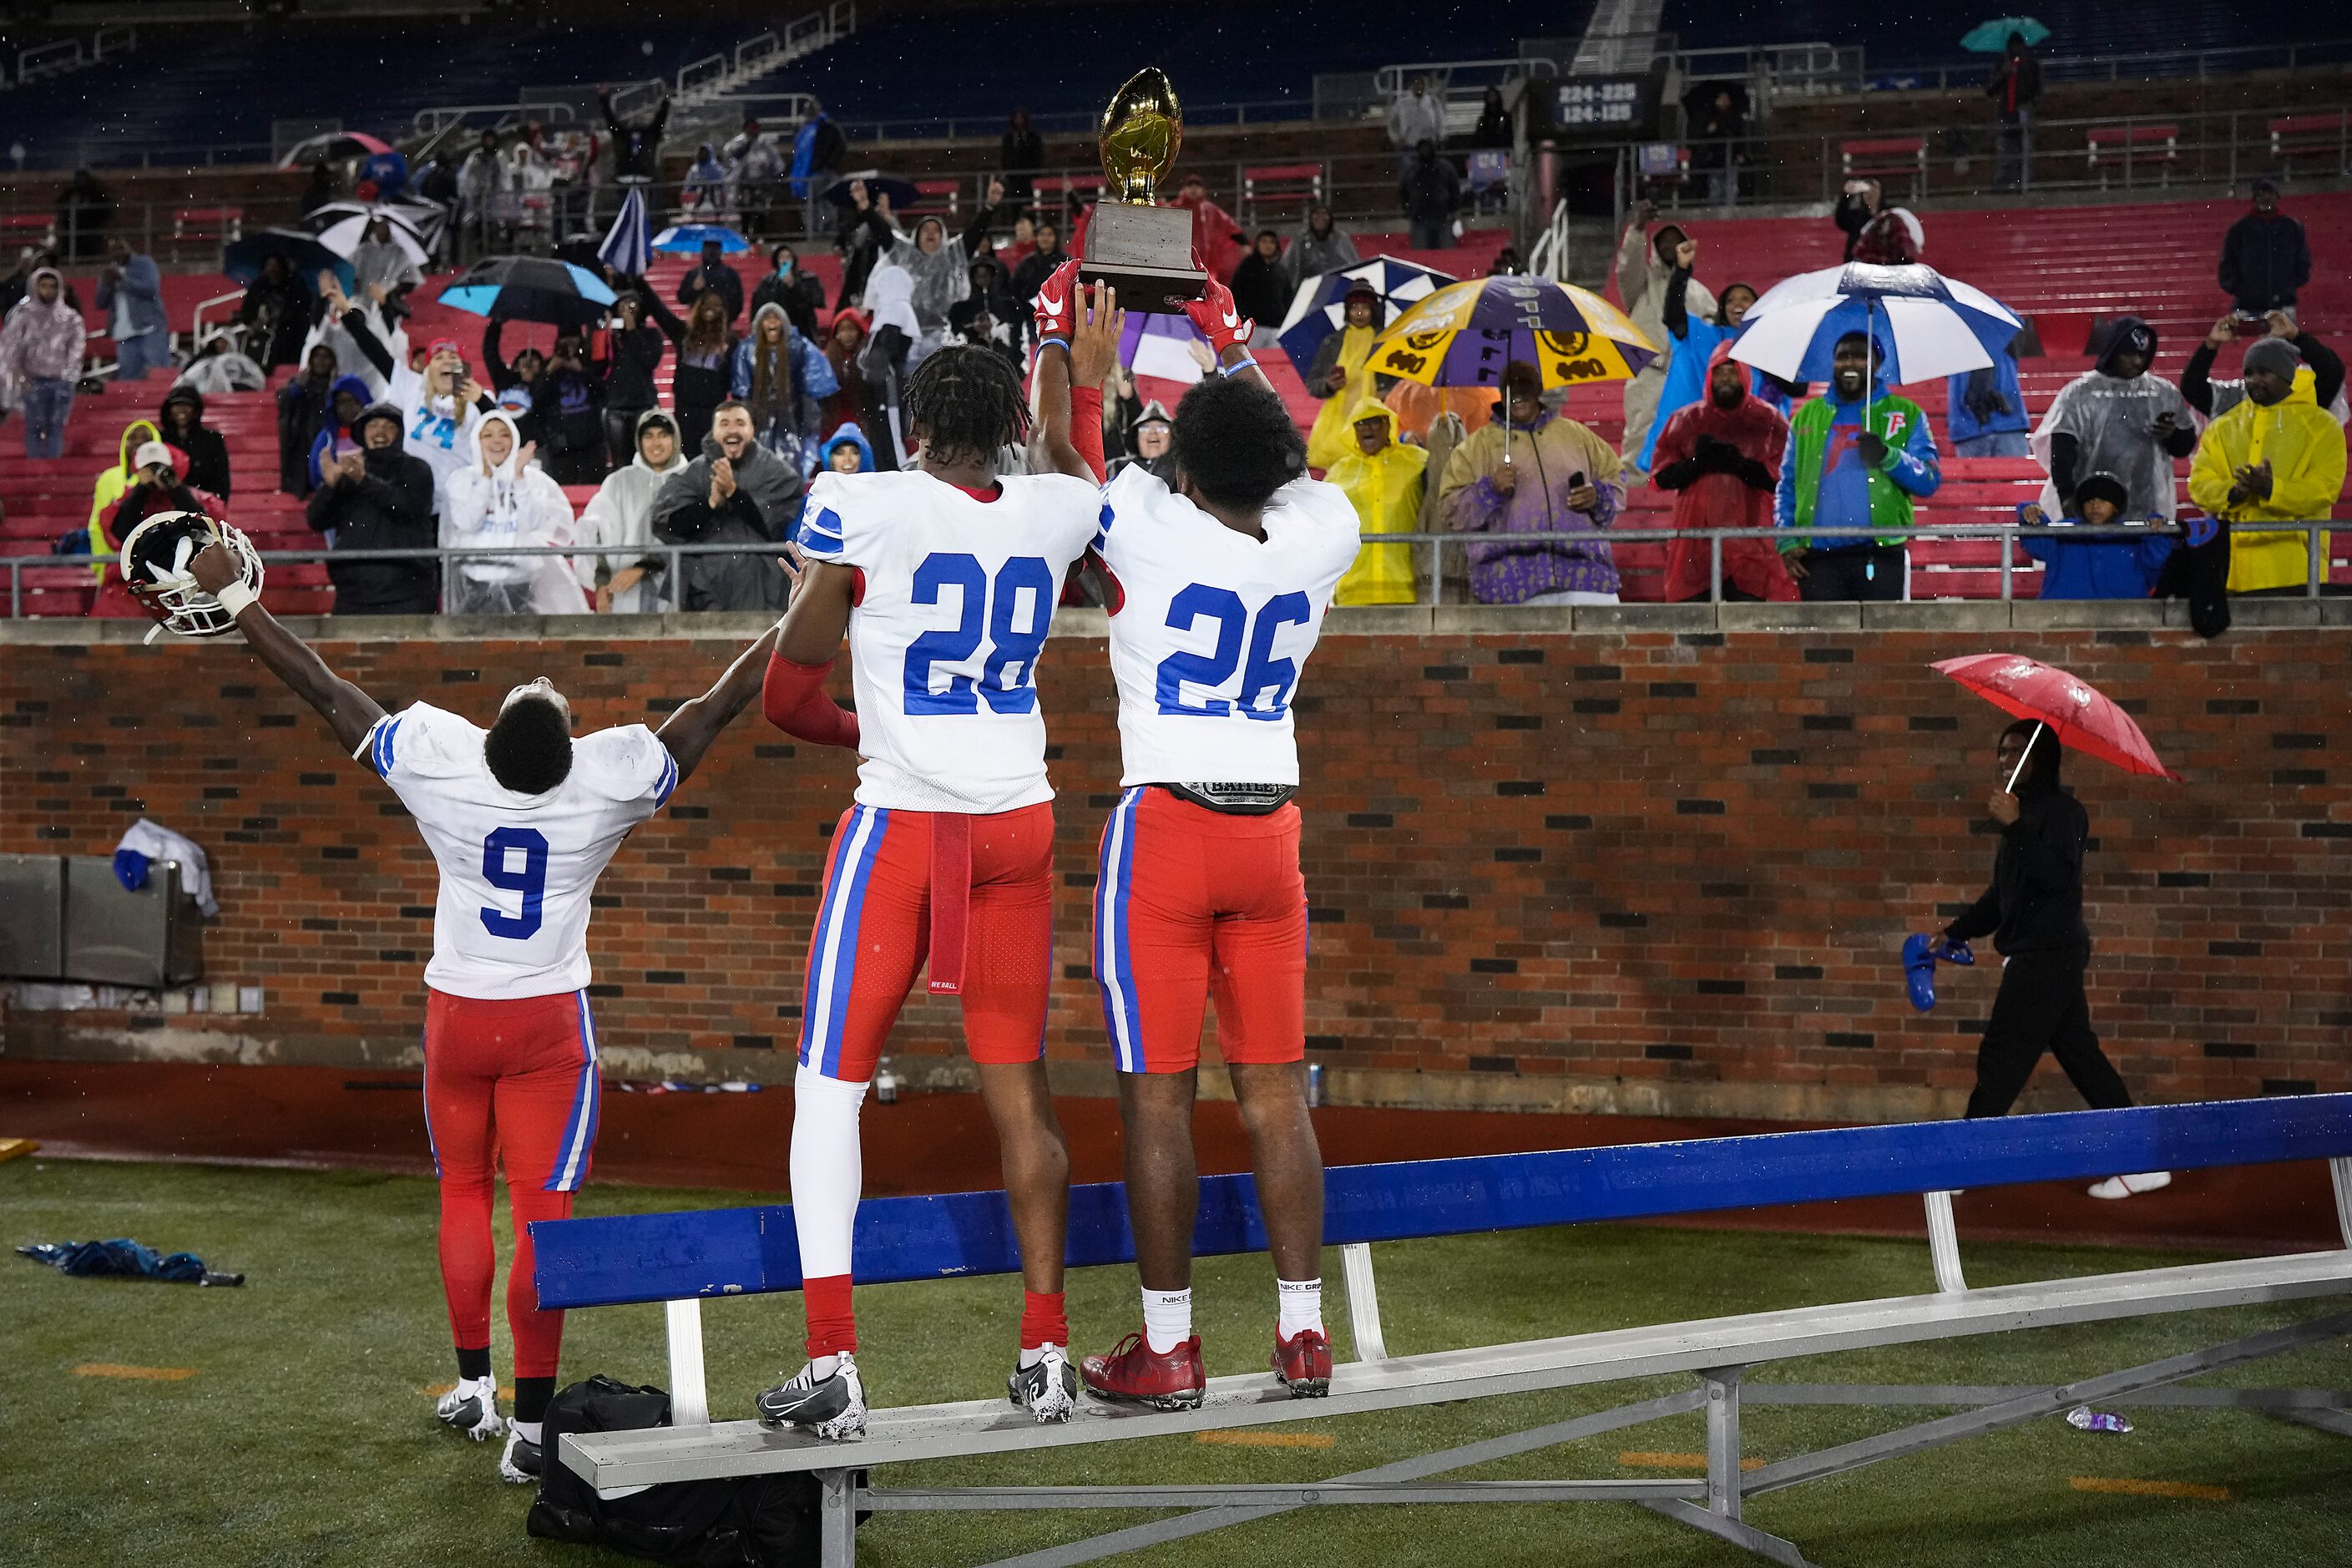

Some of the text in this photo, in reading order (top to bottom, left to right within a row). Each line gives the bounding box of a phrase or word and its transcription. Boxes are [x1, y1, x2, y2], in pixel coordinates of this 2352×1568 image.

[411, 406, 456, 451] 74
[903, 552, 1054, 716] 28
[1156, 582, 1311, 721] 26
[480, 827, 549, 940] 9
[1162, 1294, 1188, 1303] NIKE
